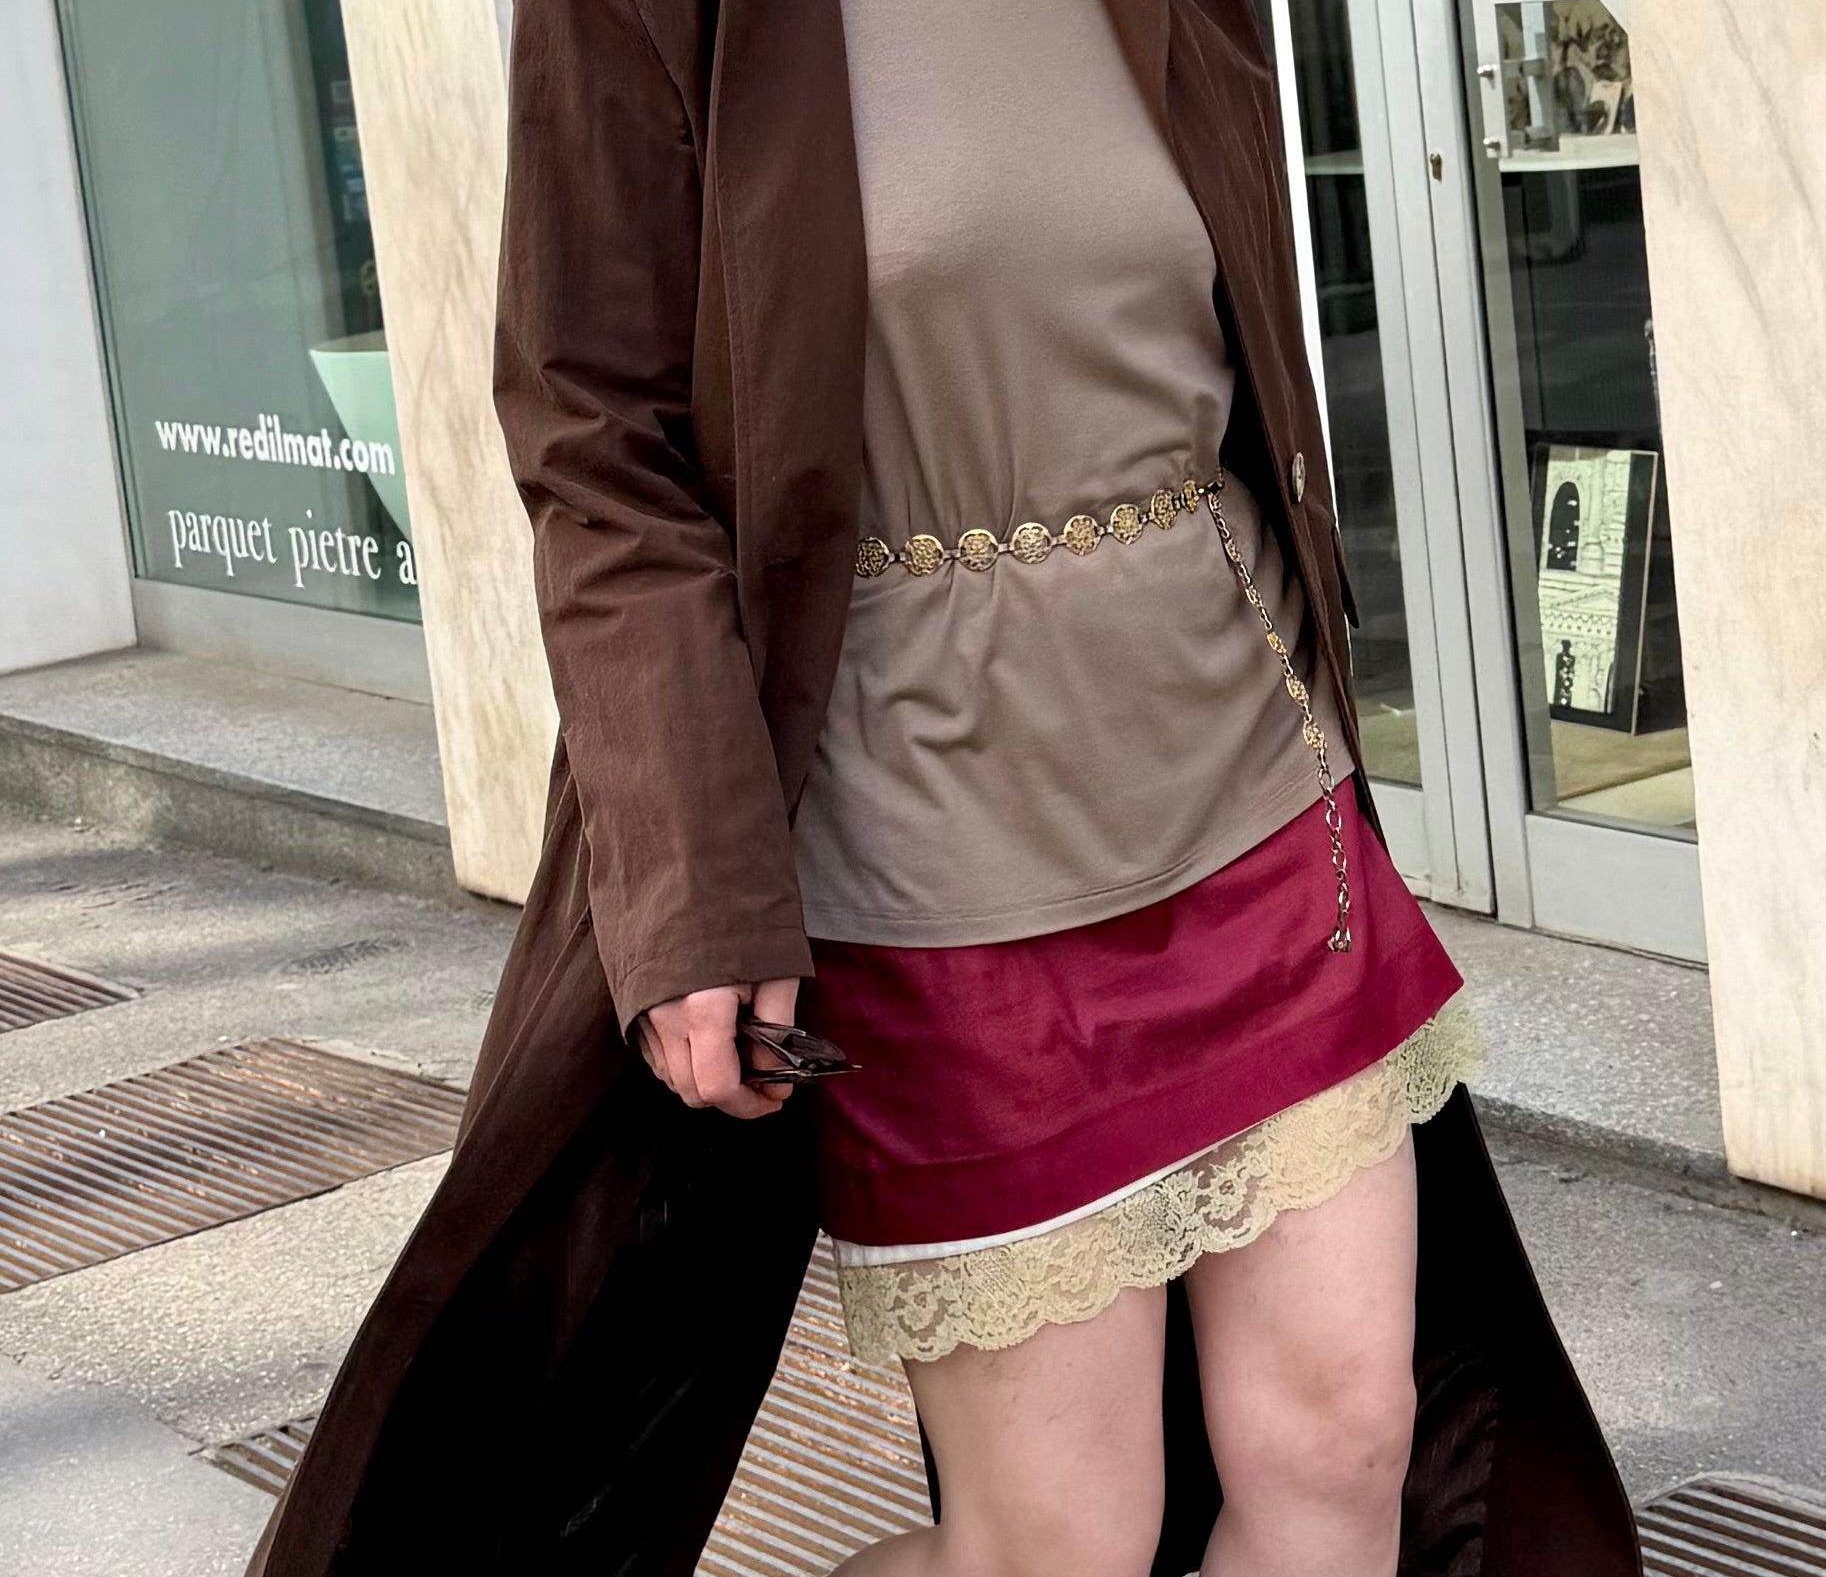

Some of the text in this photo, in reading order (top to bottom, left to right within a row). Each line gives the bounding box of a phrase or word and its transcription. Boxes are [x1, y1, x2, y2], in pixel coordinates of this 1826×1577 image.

[155, 413, 395, 475] www.redilmat.com
[167, 509, 277, 577] parquet
[288, 509, 382, 588] pietre
